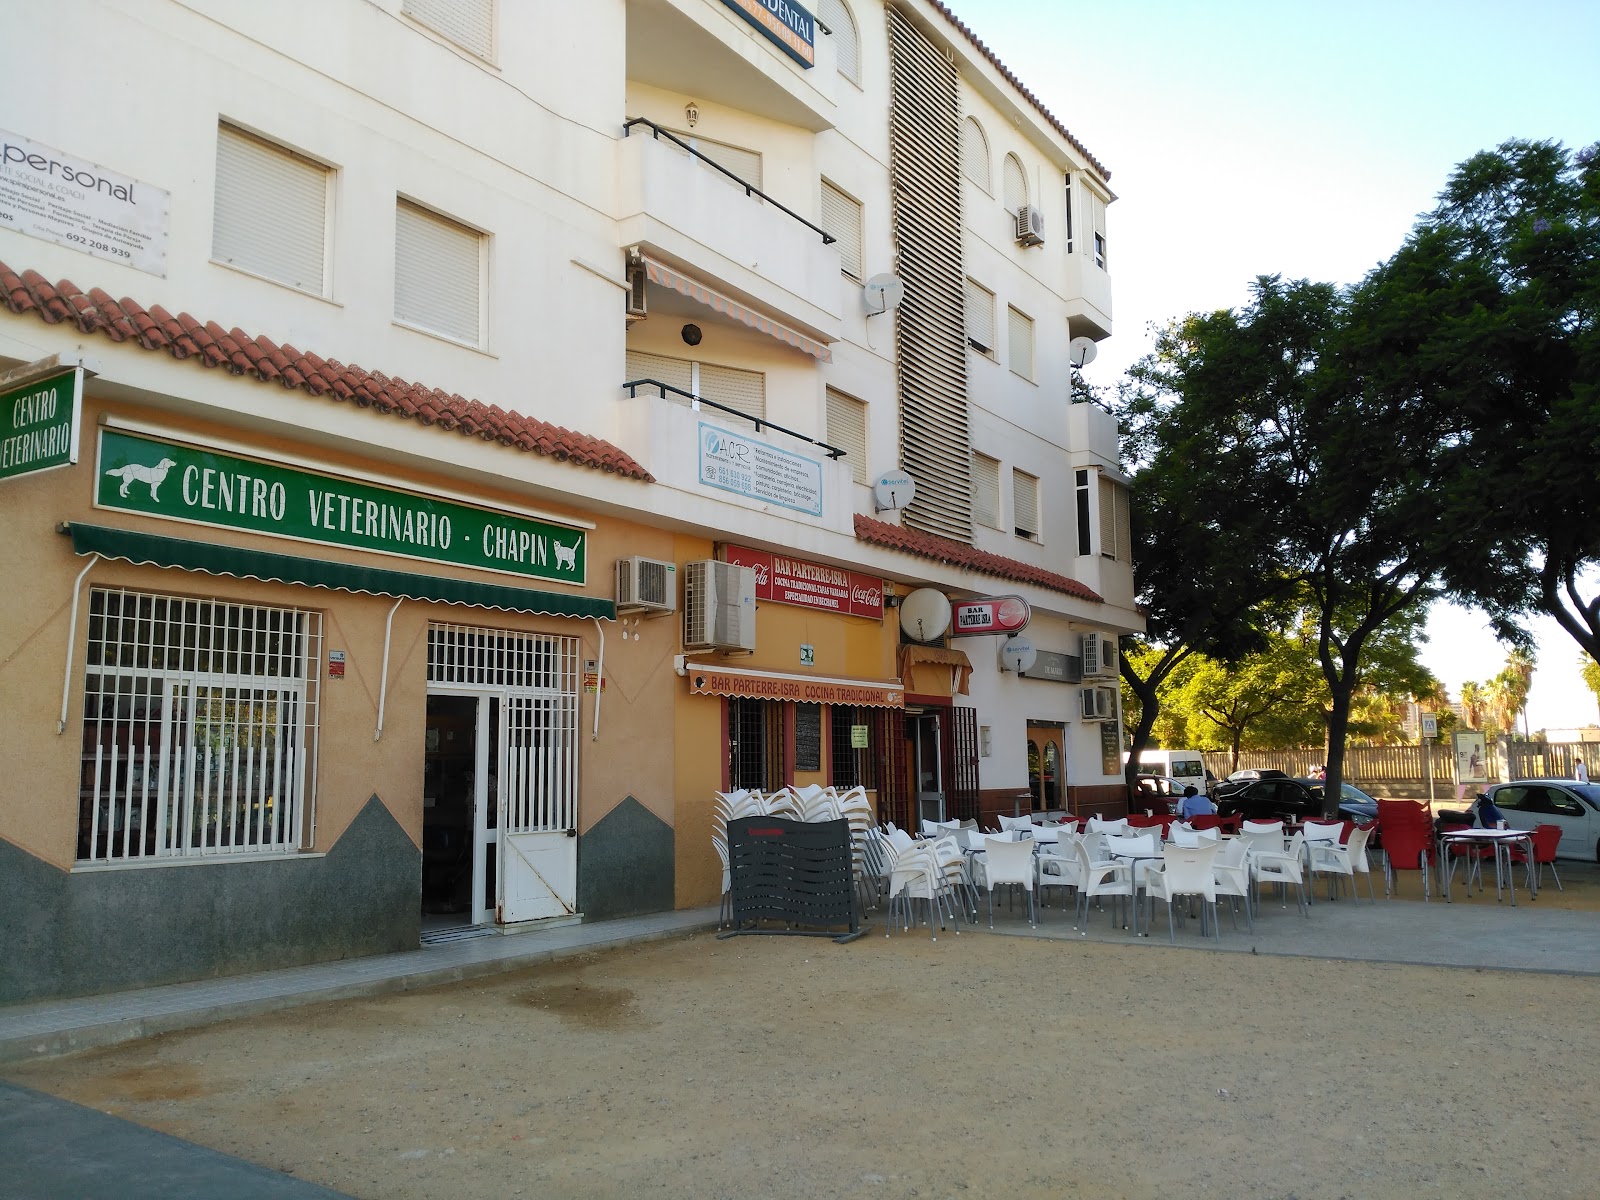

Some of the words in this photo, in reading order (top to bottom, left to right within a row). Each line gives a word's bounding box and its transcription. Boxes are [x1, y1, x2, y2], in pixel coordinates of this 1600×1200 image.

[0, 143, 136, 205] personal
[16, 170, 46, 187] SOCIAL
[66, 232, 86, 245] 692
[89, 239, 108, 252] 208
[111, 246, 130, 258] 939
[14, 388, 56, 428] CENTRO
[182, 464, 286, 521] CENTRO
[308, 489, 452, 550] VETERINARIO
[482, 524, 548, 566] CHAPIN
[774, 558, 791, 575] BAR
[792, 562, 848, 588] PARTERRE-ISRA
[711, 676, 731, 690] BAR
[733, 678, 800, 696] PARTERRE-ISRA
[805, 688, 834, 699] COCINA
[837, 688, 884, 702] TRADICIONAL
